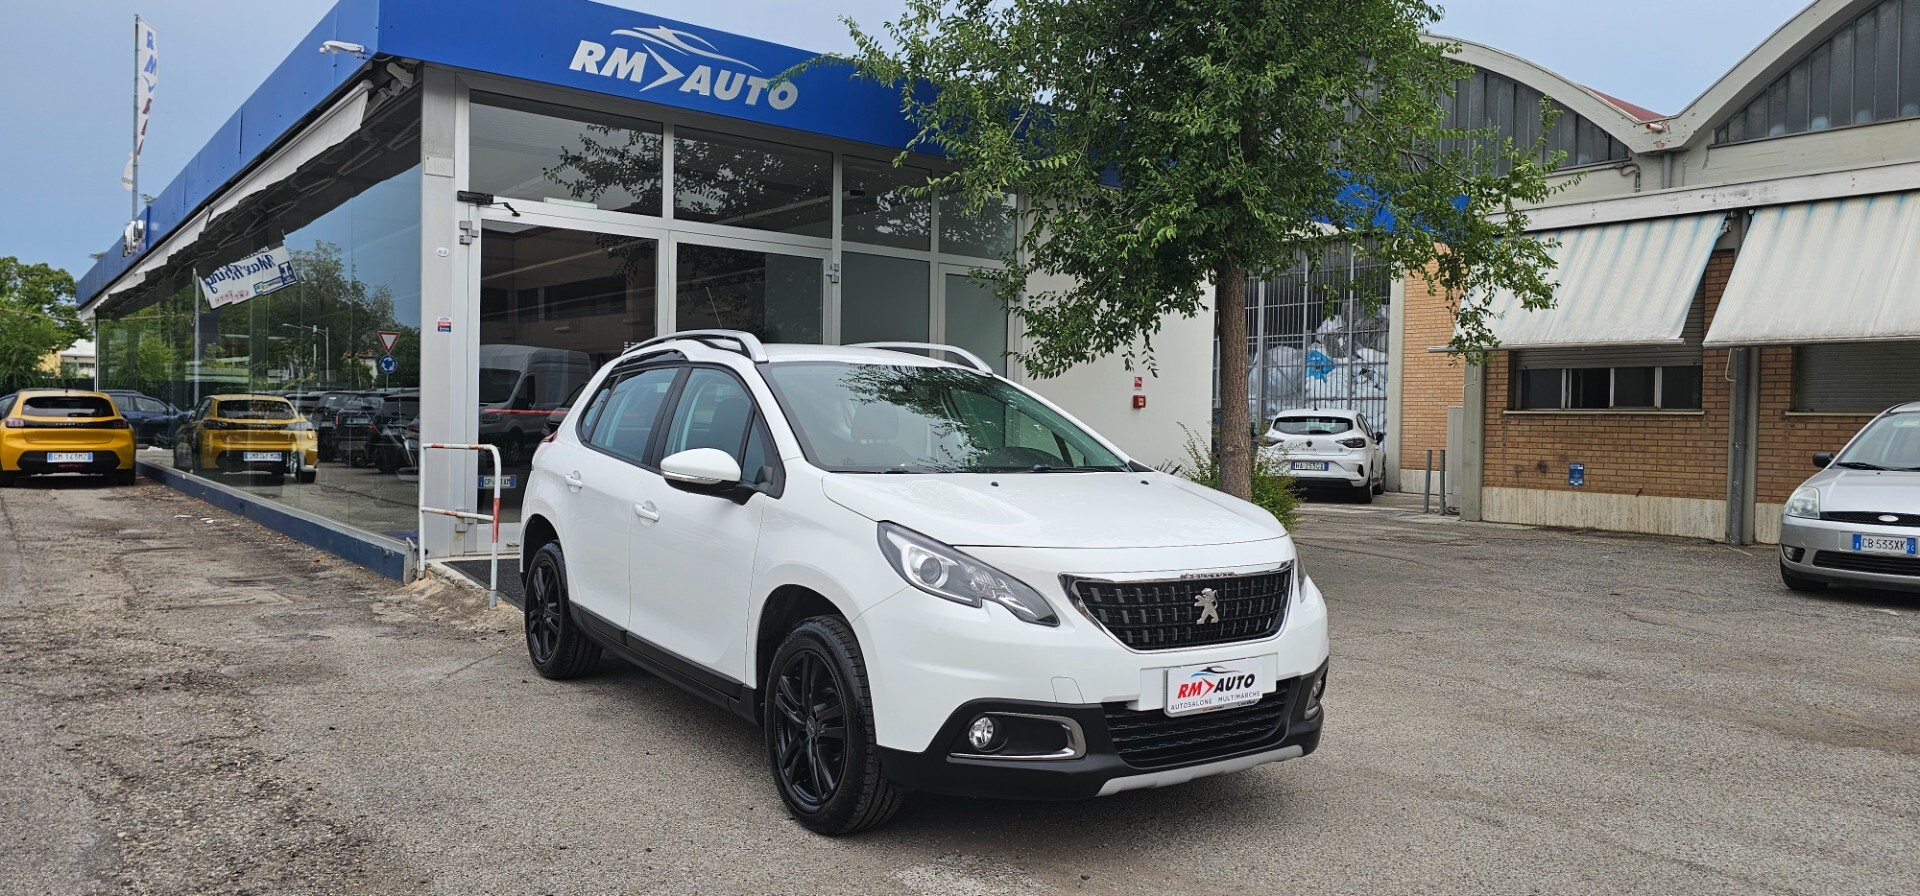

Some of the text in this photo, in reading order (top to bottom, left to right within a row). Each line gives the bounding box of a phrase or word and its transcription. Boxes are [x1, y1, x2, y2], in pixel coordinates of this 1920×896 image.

[678, 64, 799, 111] AUTO
[1862, 537, 1874, 549] CB
[1876, 539, 1906, 551] 533XK
[1213, 673, 1256, 694] AUTO
[1170, 697, 1213, 711] AUTOSALONE
[1217, 690, 1261, 702] MULTIMARCHE
